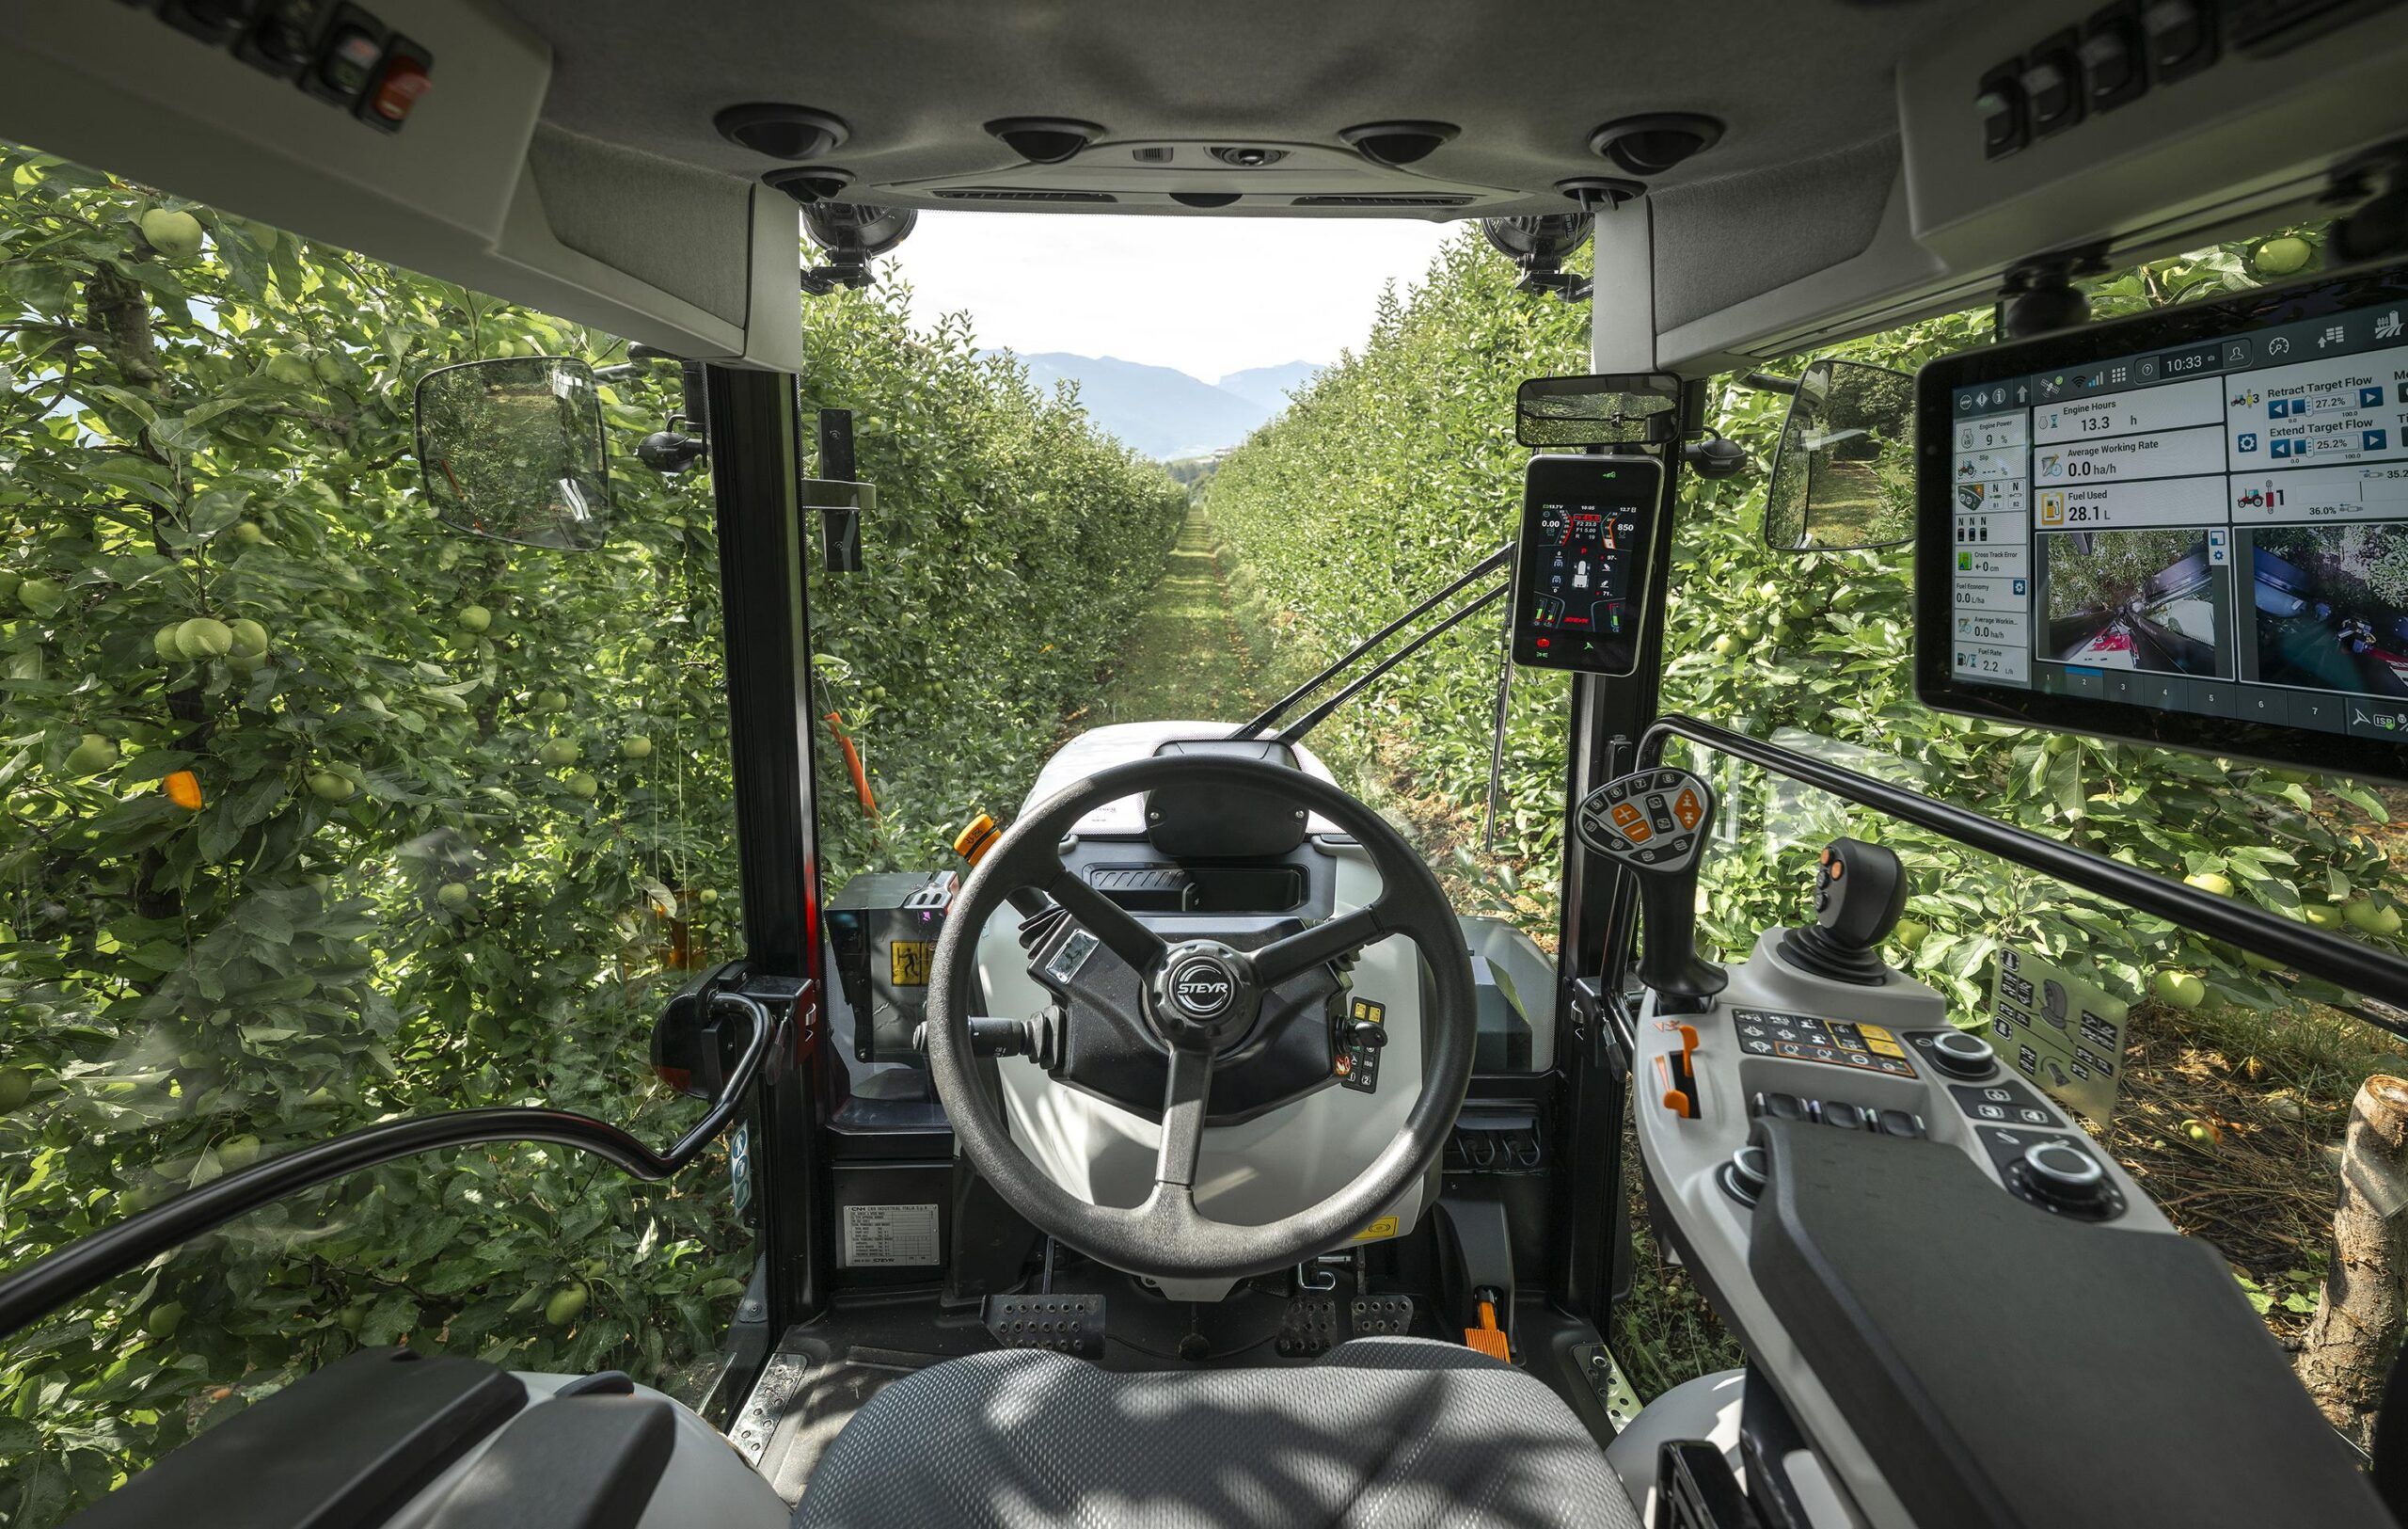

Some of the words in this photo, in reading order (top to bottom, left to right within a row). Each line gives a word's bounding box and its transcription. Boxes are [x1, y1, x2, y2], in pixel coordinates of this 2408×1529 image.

[2166, 355, 2202, 372] 10:33
[2268, 386, 2305, 398] Retract
[2306, 379, 2342, 393] Target
[2345, 376, 2372, 388] Flow
[2253, 393, 2259, 404] 3
[2315, 397, 2346, 408] 27.2%
[2063, 406, 2090, 416] Engine
[2091, 400, 2116, 411] Hours
[1979, 422, 1996, 431] Engine
[1996, 420, 2013, 428] Power
[2081, 416, 2110, 432] 13.3
[2130, 415, 2137, 425] h
[2270, 425, 2305, 438] Extend
[2307, 421, 2343, 434] Target
[2346, 418, 2373, 429] Flow
[1986, 434, 1993, 446] 9
[2317, 438, 2348, 450] 25.2%
[2067, 449, 2099, 458] Average
[2100, 444, 2136, 454] Working
[2138, 440, 2159, 450] Rate
[2068, 461, 2091, 477] 0.0
[2093, 464, 2116, 475] ha/h
[1992, 484, 1999, 492] N
[2013, 482, 2020, 490] N
[2068, 491, 2085, 501] Fuel
[2086, 490, 2108, 500] Used
[2276, 489, 2285, 505] 1
[2068, 505, 2099, 521] 28.1
[2104, 510, 2111, 520] L
[2309, 506, 2337, 516] 36.0%
[1958, 518, 1964, 526] N
[1970, 517, 1975, 525] N
[1981, 517, 1987, 525] N
[1968, 583, 1989, 592] Economy
[1956, 592, 1971, 603] 0.0
[1974, 616, 1994, 625] Average
[1974, 626, 1989, 637] 0.0
[1983, 661, 1999, 672] 2.2
[1178, 982, 1228, 994] STEYR
